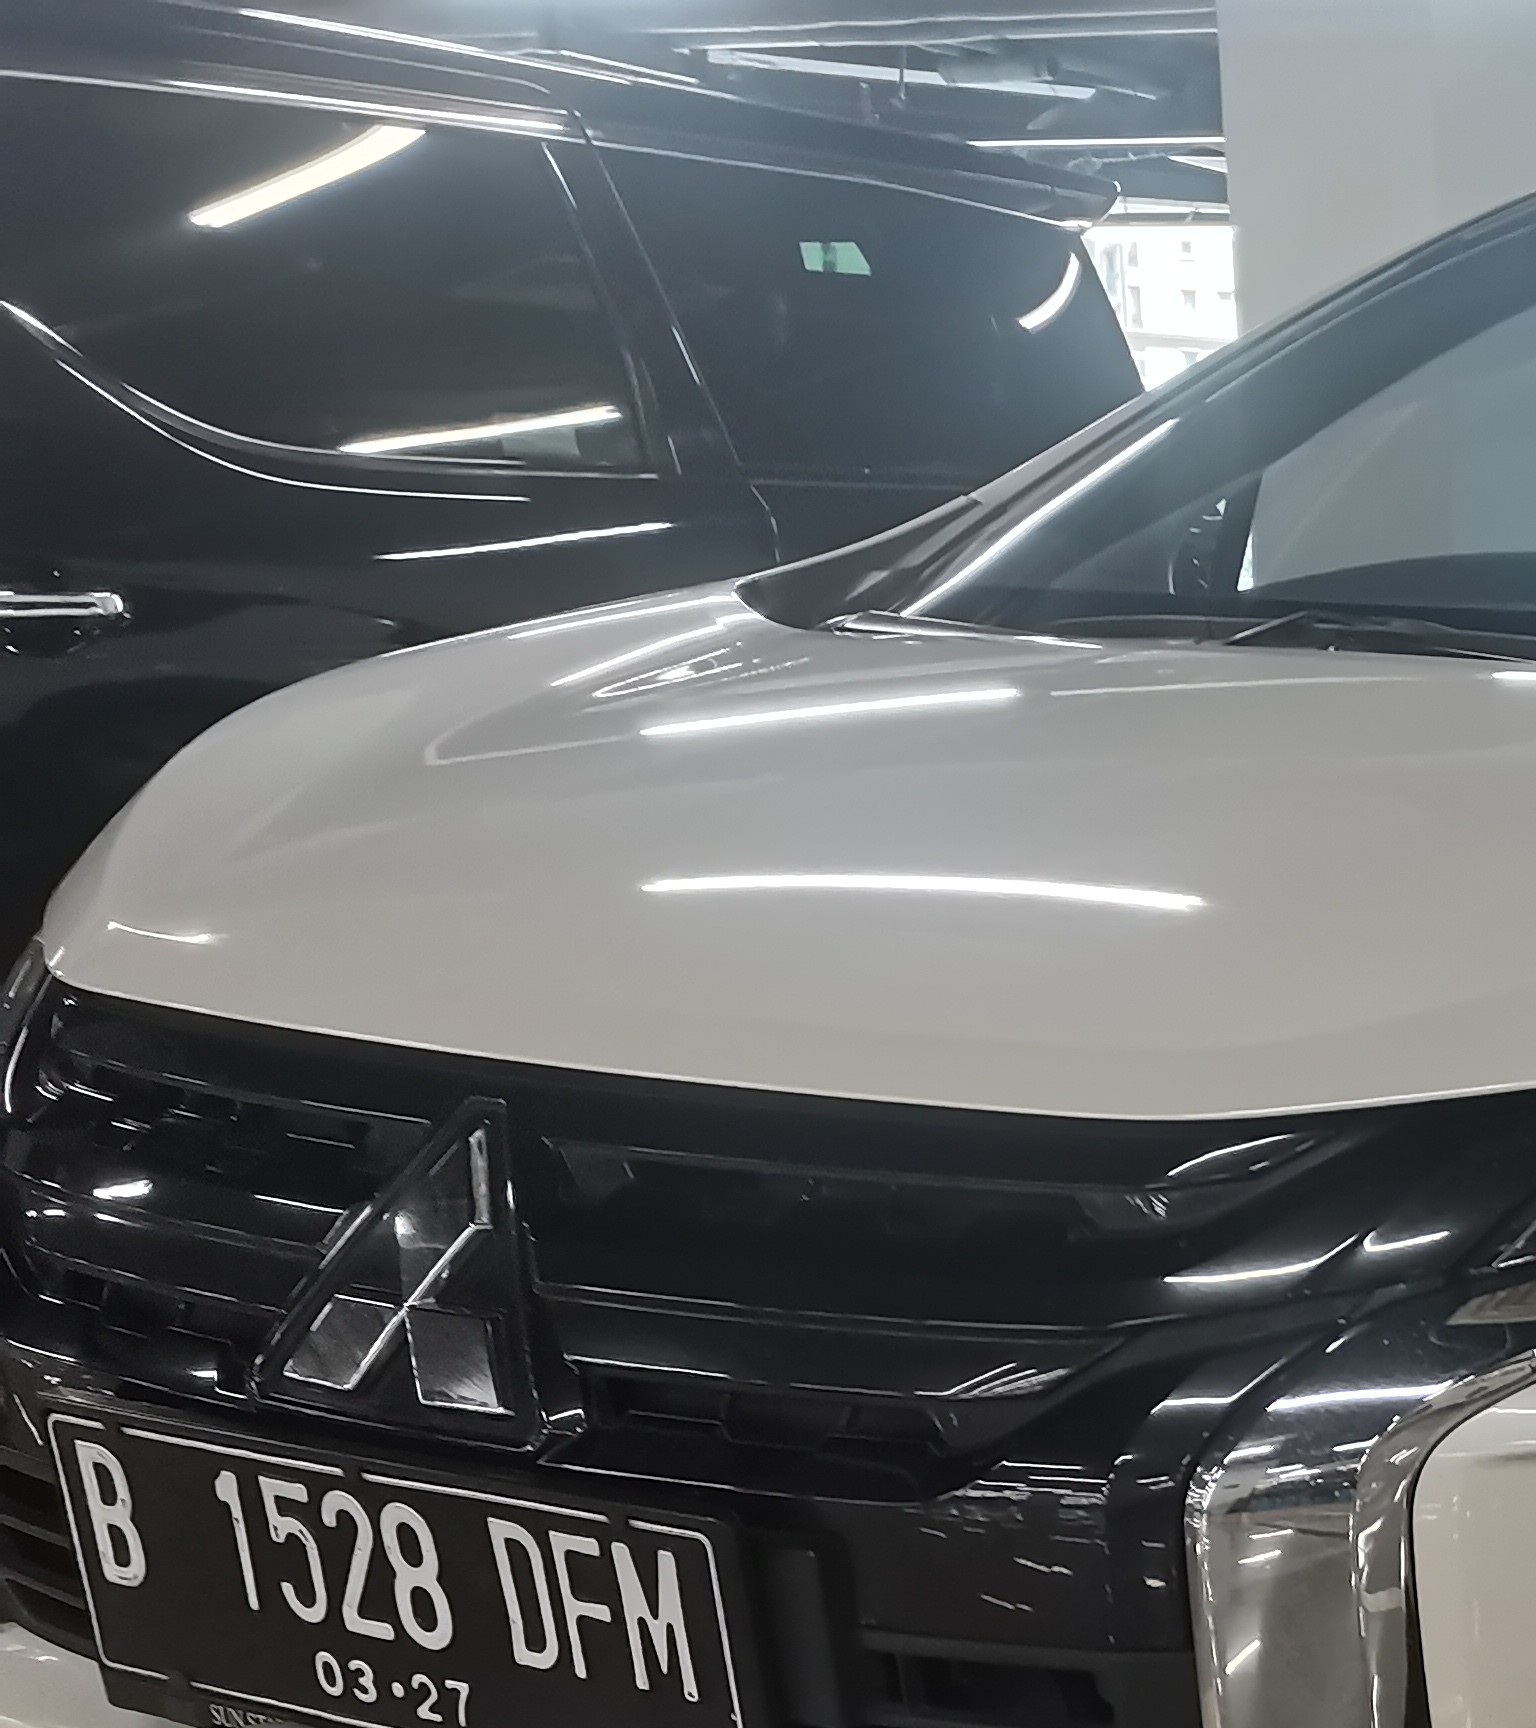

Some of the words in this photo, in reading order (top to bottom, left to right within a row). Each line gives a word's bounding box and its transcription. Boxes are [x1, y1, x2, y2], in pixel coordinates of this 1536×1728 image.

[73, 1439, 146, 1587] B
[214, 1470, 453, 1651] 1528
[486, 1516, 700, 1704] DFM
[209, 1703, 245, 1728] SUN
